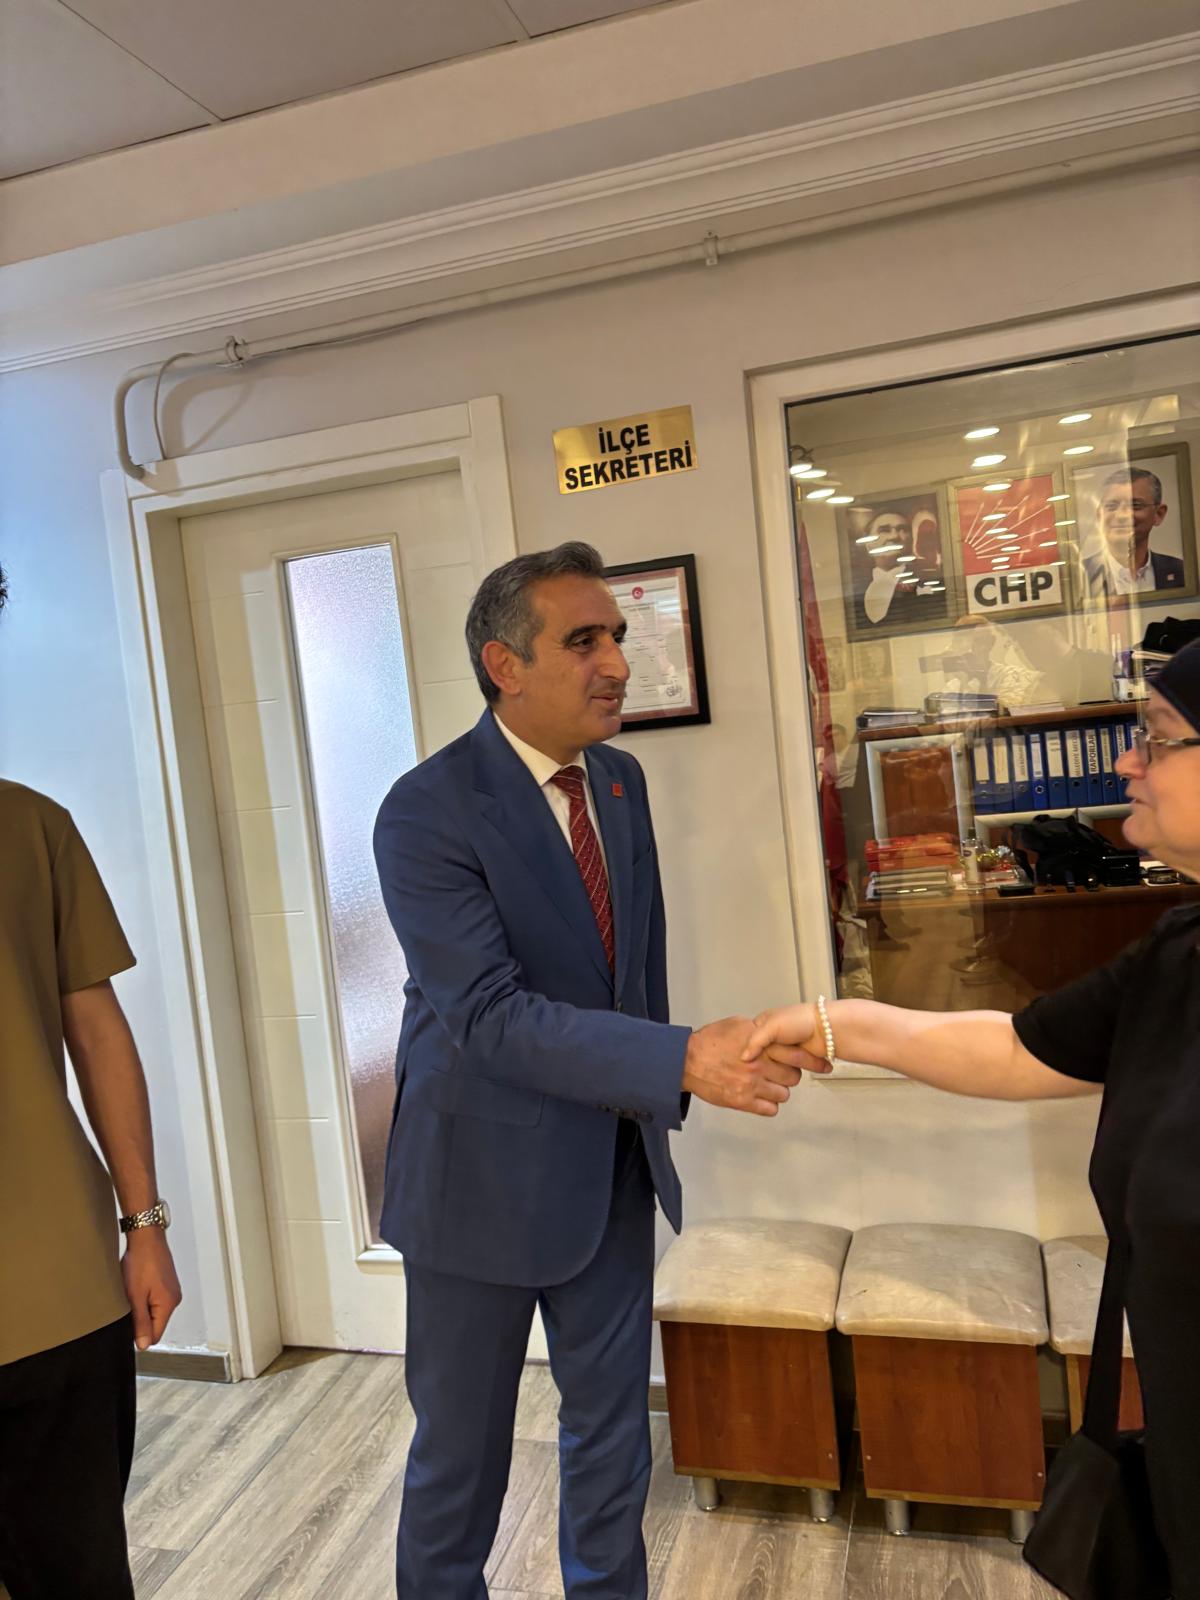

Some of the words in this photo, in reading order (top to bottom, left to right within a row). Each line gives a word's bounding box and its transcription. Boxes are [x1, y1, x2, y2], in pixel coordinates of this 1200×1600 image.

[598, 424, 651, 455] İLÇE
[565, 440, 692, 490] SEKRETERİ
[973, 571, 1054, 607] CHP
